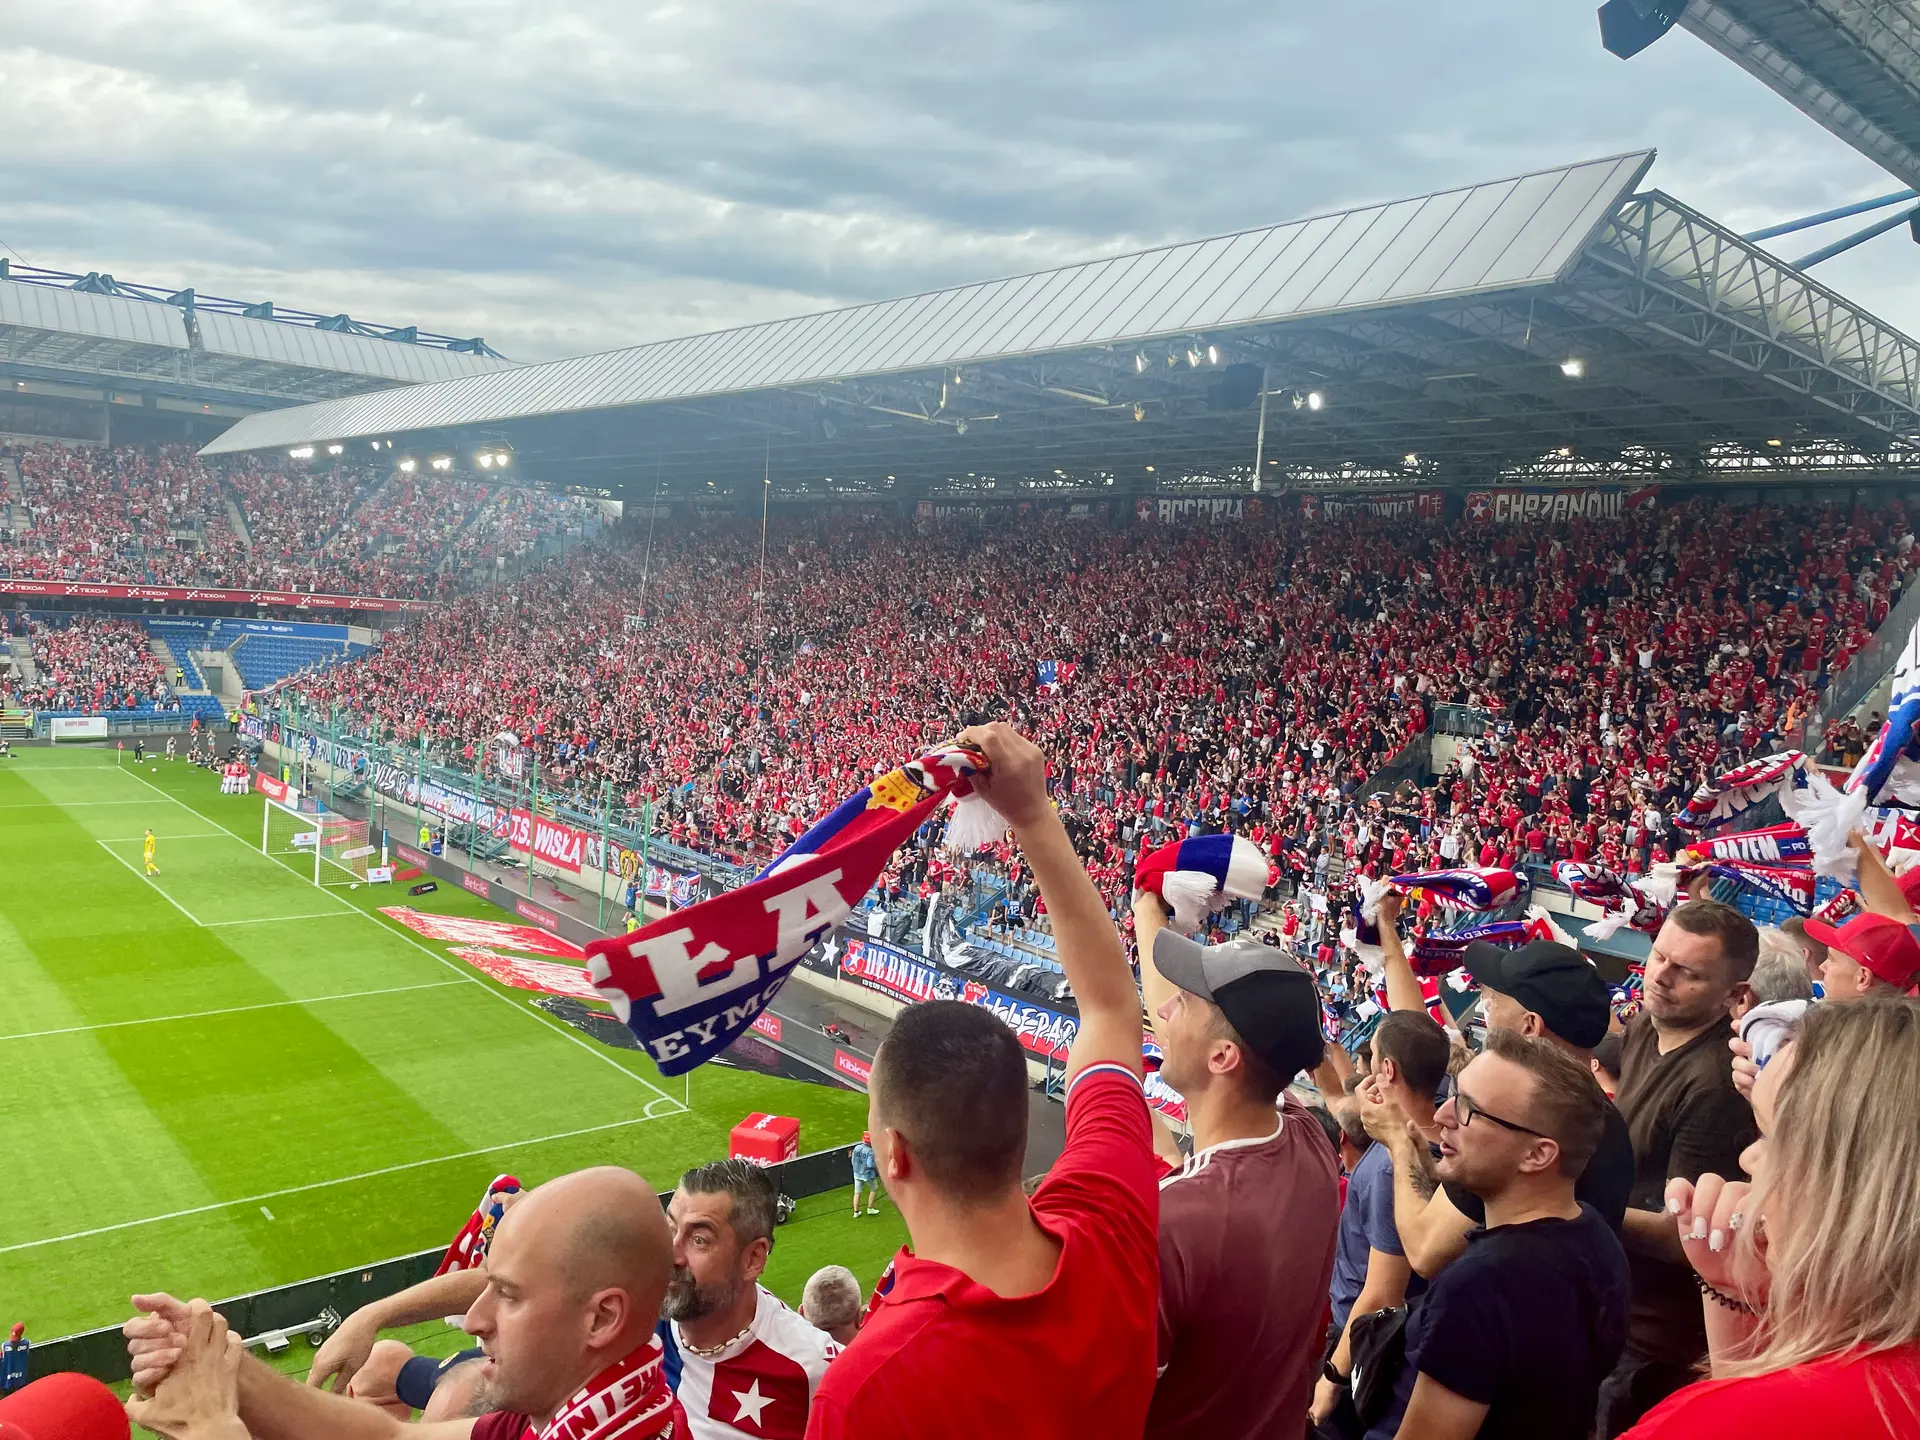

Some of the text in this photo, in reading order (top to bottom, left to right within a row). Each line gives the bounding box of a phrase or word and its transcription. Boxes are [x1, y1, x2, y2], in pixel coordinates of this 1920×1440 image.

[15, 584, 46, 592] TEXOM
[79, 587, 109, 595] TEXOM
[1037, 660, 1075, 679] WISŁA
[509, 815, 580, 866] T.S. WISŁA
[464, 875, 488, 896] Betclic
[864, 947, 935, 1000] DĘBNIKI
[839, 1056, 871, 1080] Kibice
